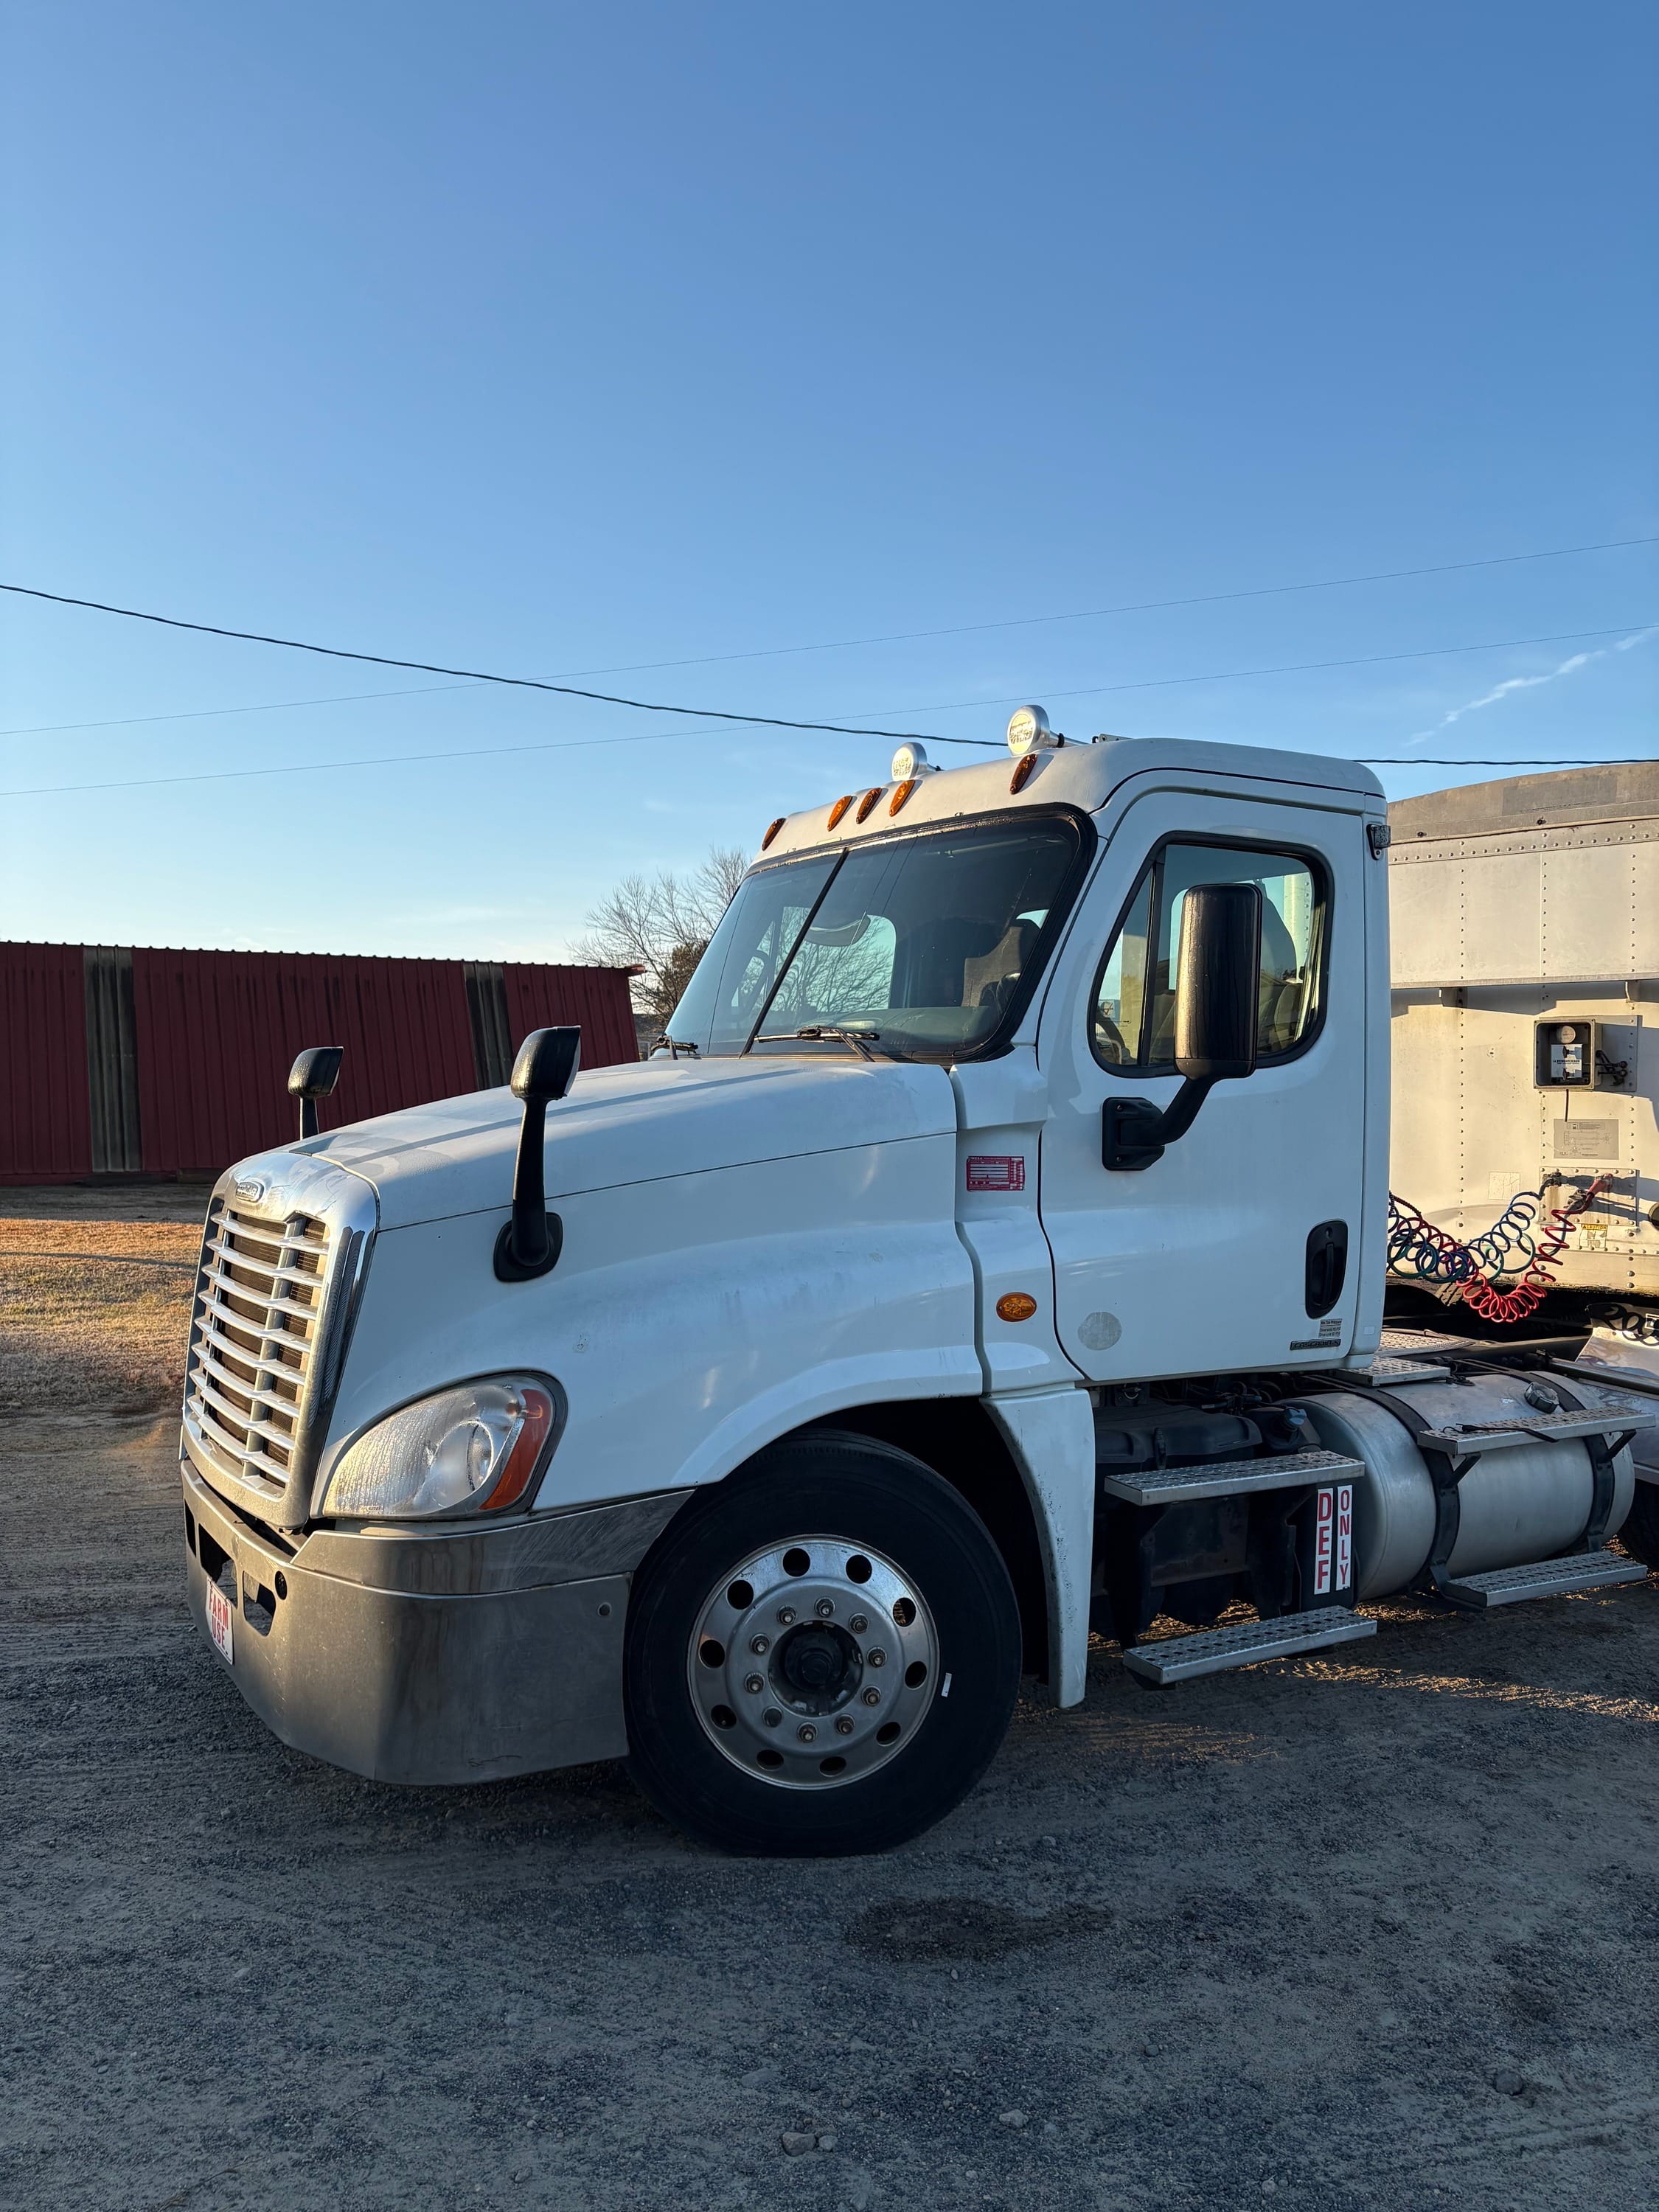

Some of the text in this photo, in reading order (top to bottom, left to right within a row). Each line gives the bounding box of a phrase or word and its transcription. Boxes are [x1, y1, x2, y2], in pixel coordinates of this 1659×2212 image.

[1317, 1492, 1332, 1590] DEF
[1339, 1489, 1350, 1585] ONLY
[209, 1585, 229, 1630] FARM
[212, 1615, 225, 1649] USE
